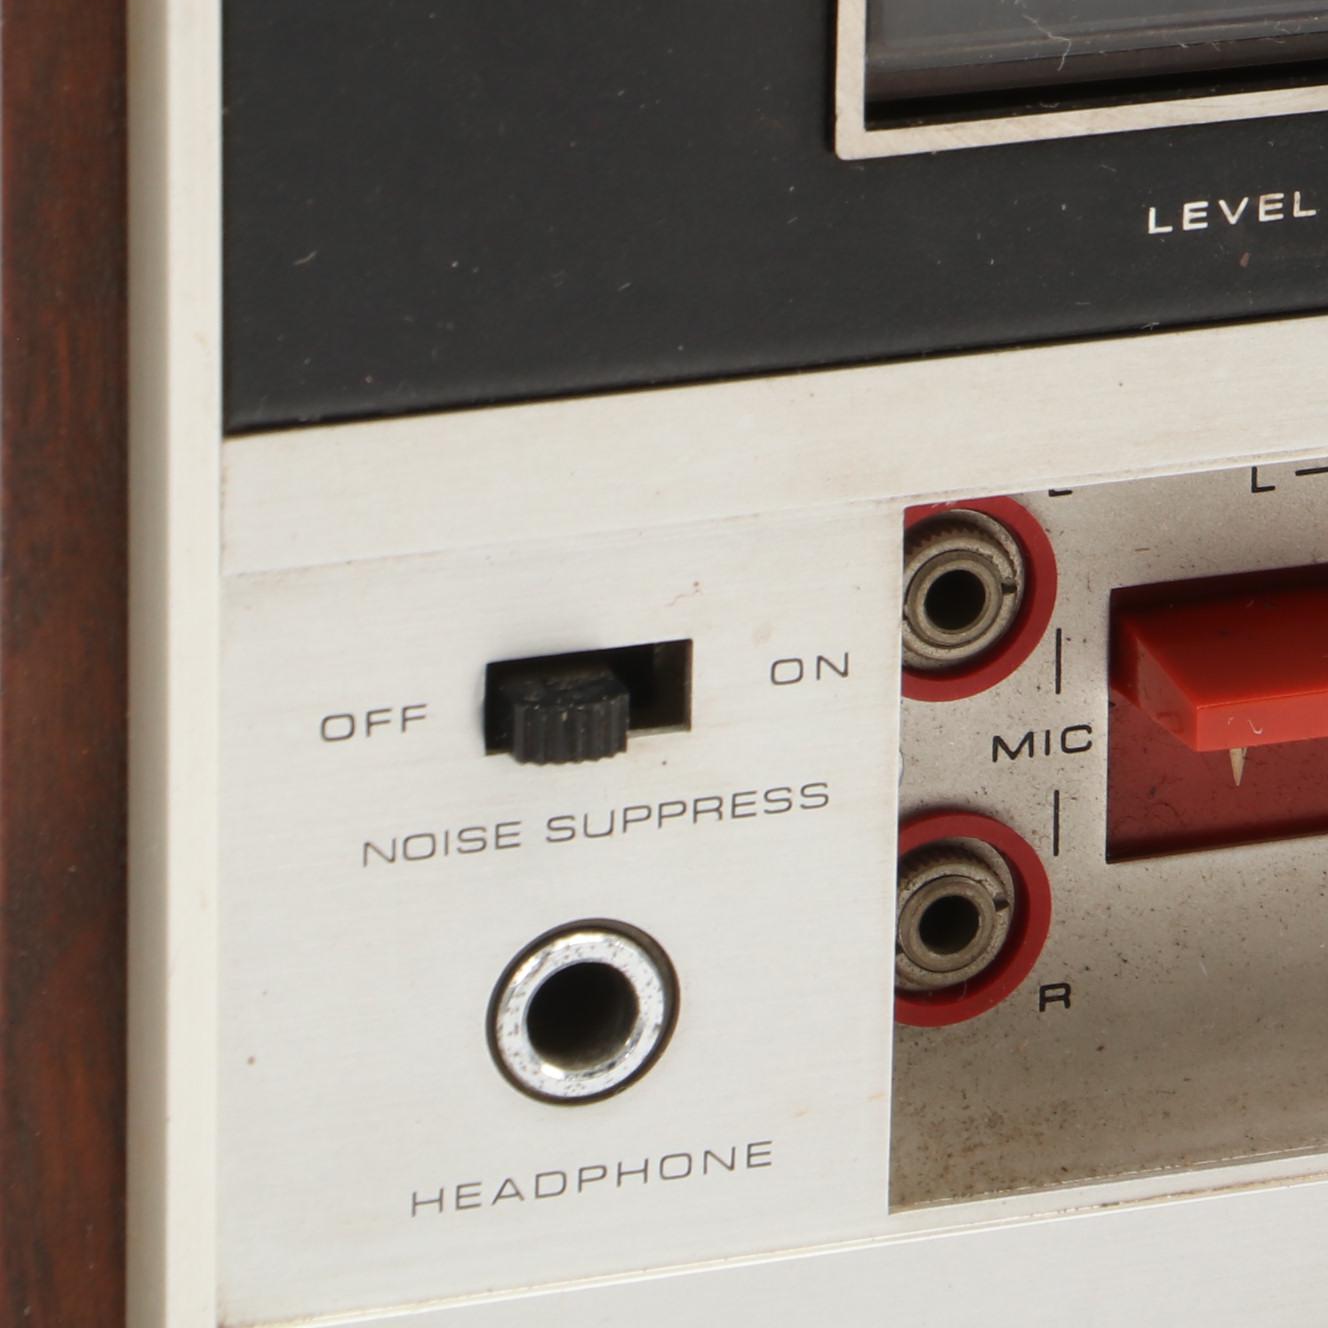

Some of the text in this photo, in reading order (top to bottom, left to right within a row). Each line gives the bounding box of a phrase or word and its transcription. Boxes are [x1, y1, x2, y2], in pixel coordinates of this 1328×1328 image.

[1148, 191, 1317, 235] LEVEL
[1250, 466, 1276, 494] L
[770, 652, 849, 686] ON
[320, 703, 427, 743] OFF
[992, 724, 1093, 763] MIC
[363, 782, 829, 867] NOISE SUPPRESS
[1038, 982, 1072, 1013] R
[411, 1140, 773, 1217] HEADPHONE
